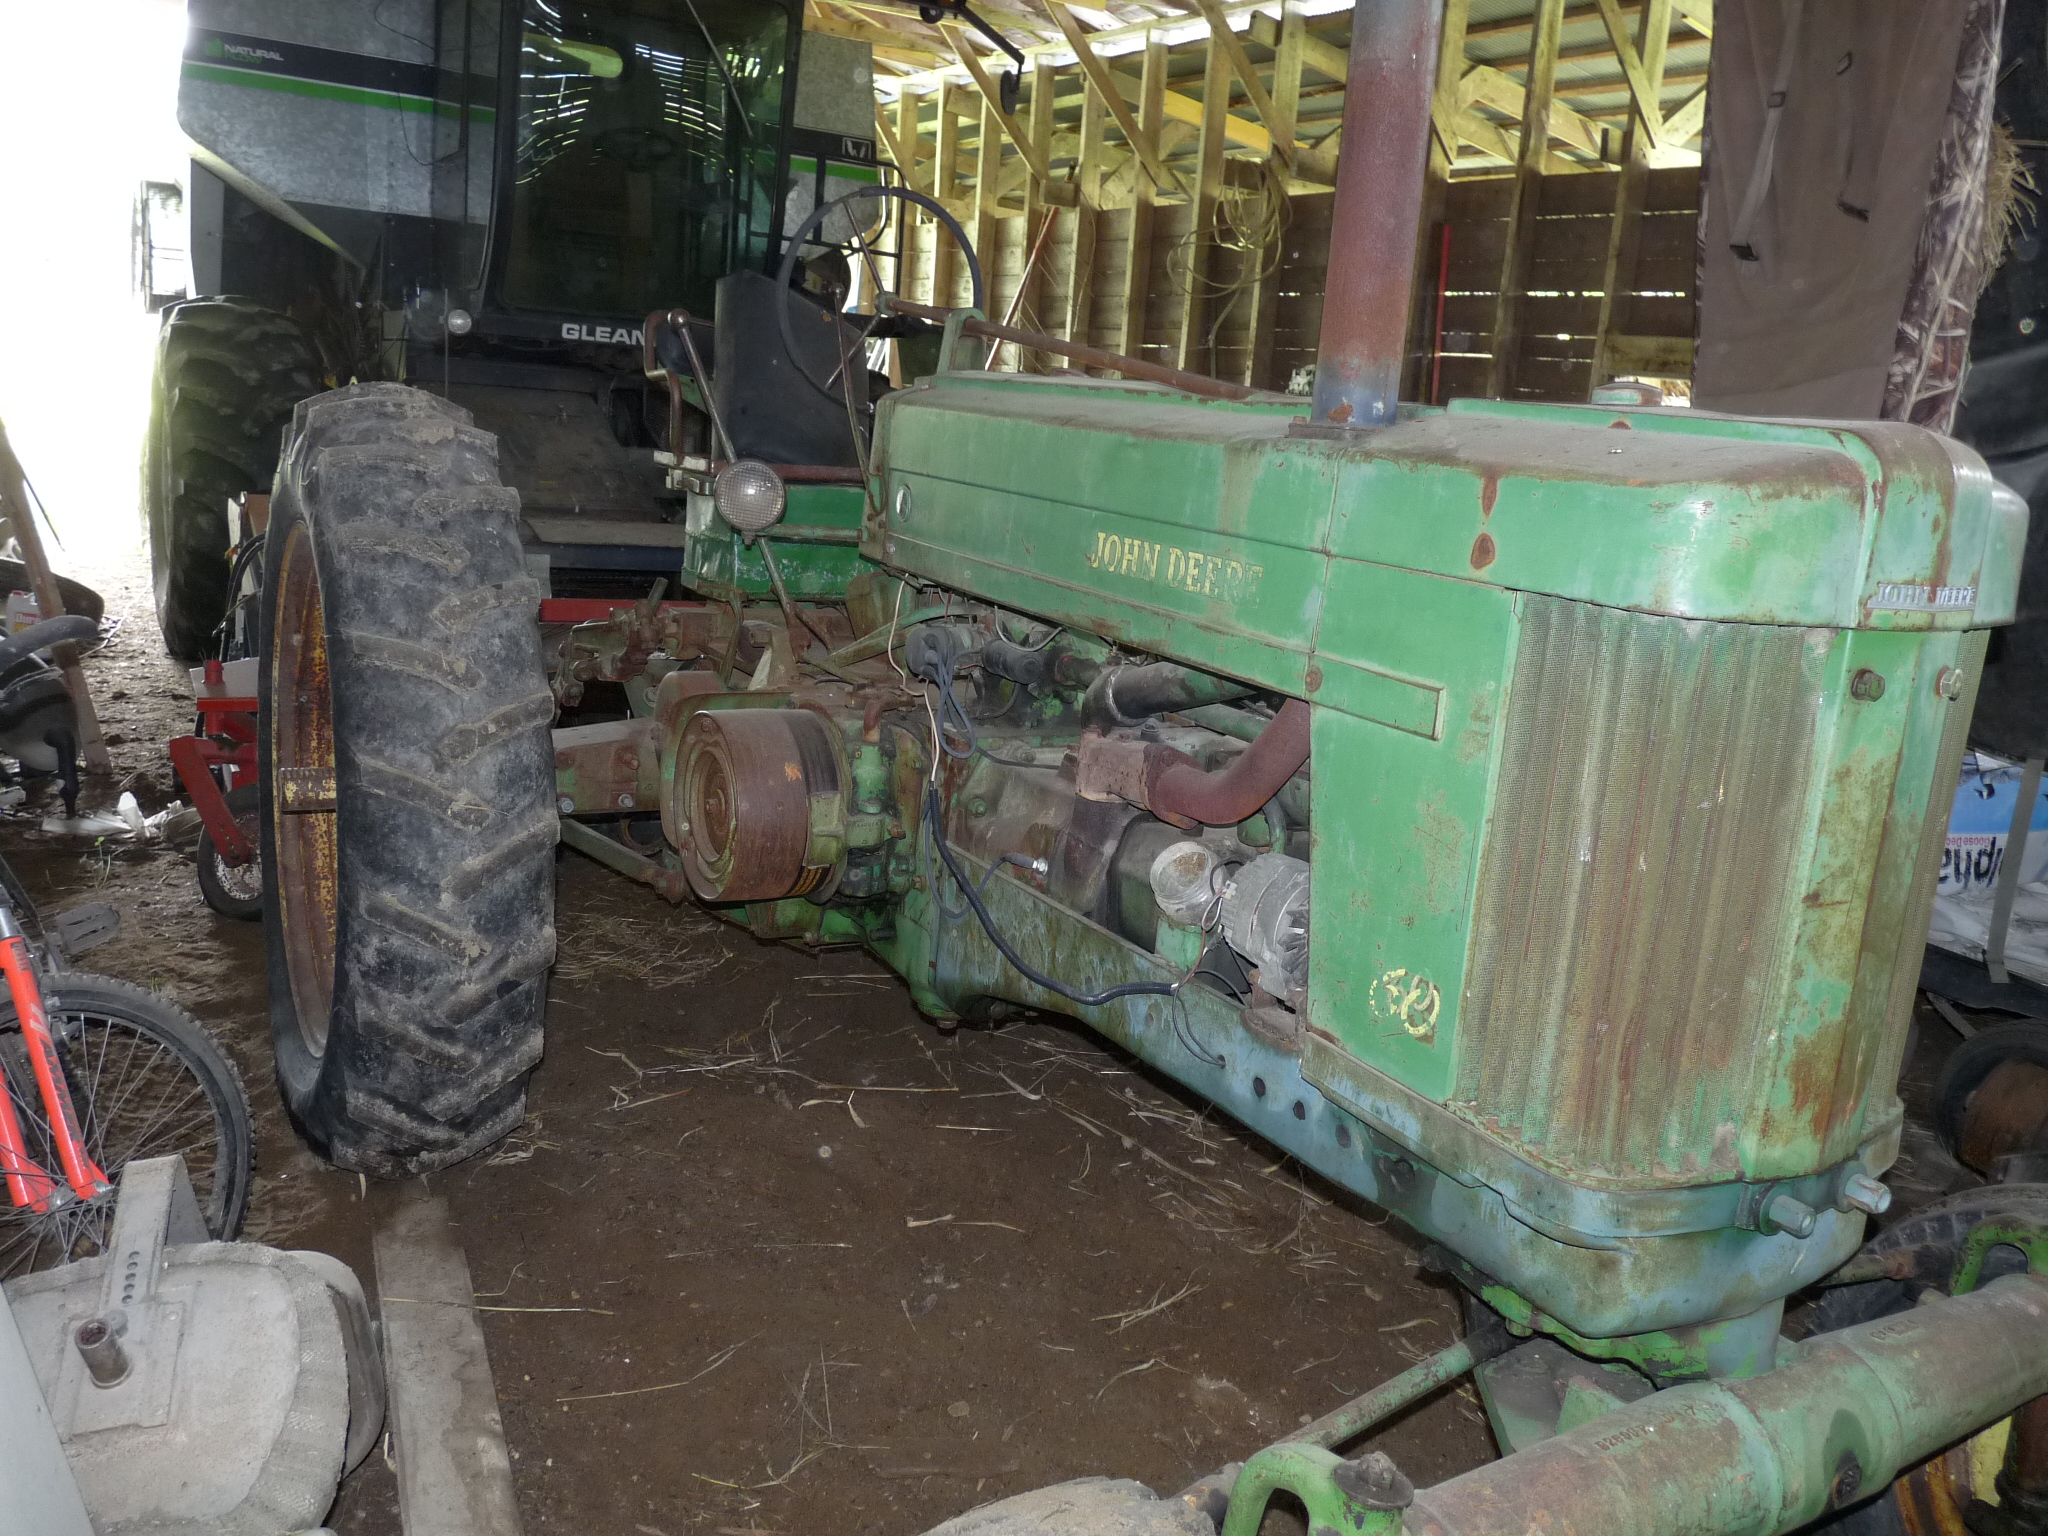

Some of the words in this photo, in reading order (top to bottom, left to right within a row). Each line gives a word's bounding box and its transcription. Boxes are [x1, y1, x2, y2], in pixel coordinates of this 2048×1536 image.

[223, 43, 284, 61] NATURAL
[562, 323, 645, 346] GLEAN
[1091, 531, 1161, 582] JOHN
[1878, 583, 1931, 606] JOHN
[1963, 837, 1990, 848] Goose
